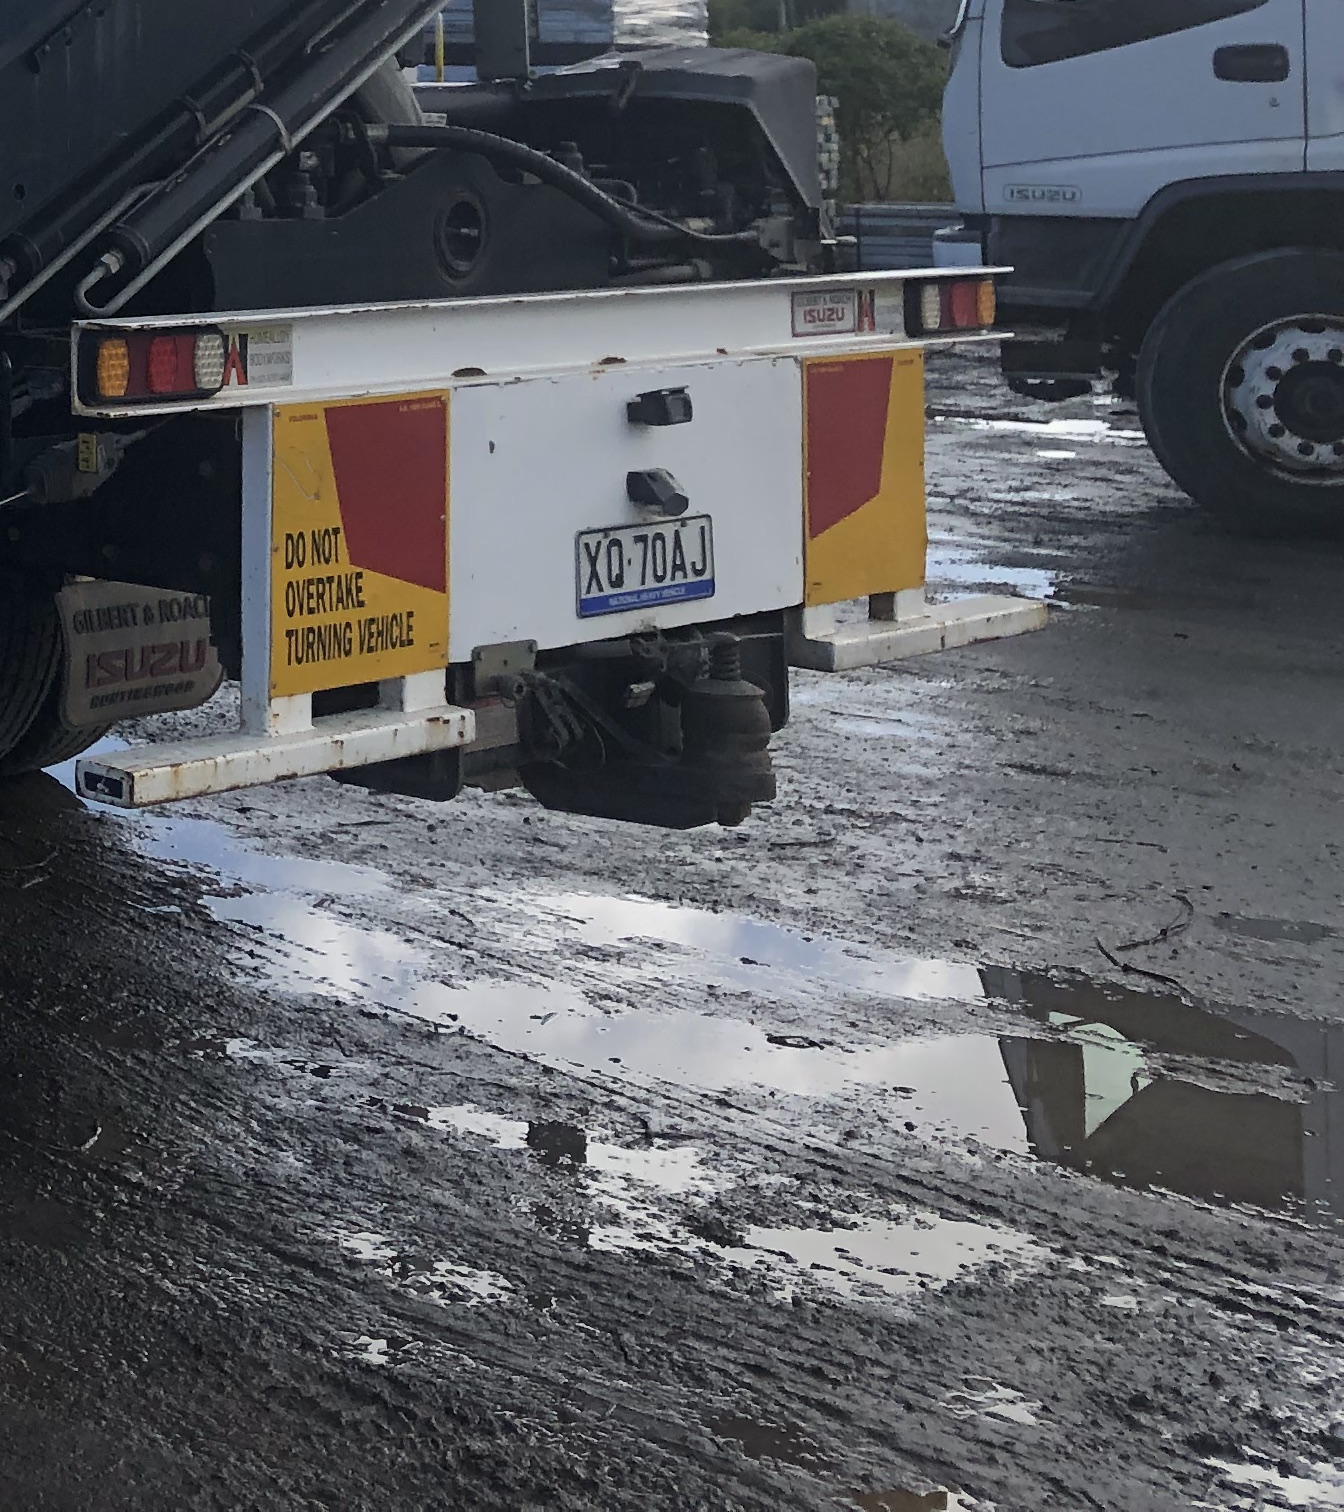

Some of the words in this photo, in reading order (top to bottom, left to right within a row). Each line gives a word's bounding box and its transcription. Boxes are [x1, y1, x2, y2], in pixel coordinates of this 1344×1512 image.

[1010, 188, 1076, 201] ISUZU
[803, 307, 846, 323] ISUZU
[285, 531, 306, 569] DO
[312, 527, 340, 566] NOT
[285, 572, 365, 618] OVERTAKE
[285, 621, 353, 665] TURNING
[357, 611, 415, 655] VEHICLE
[86, 638, 208, 688] ISUZU
